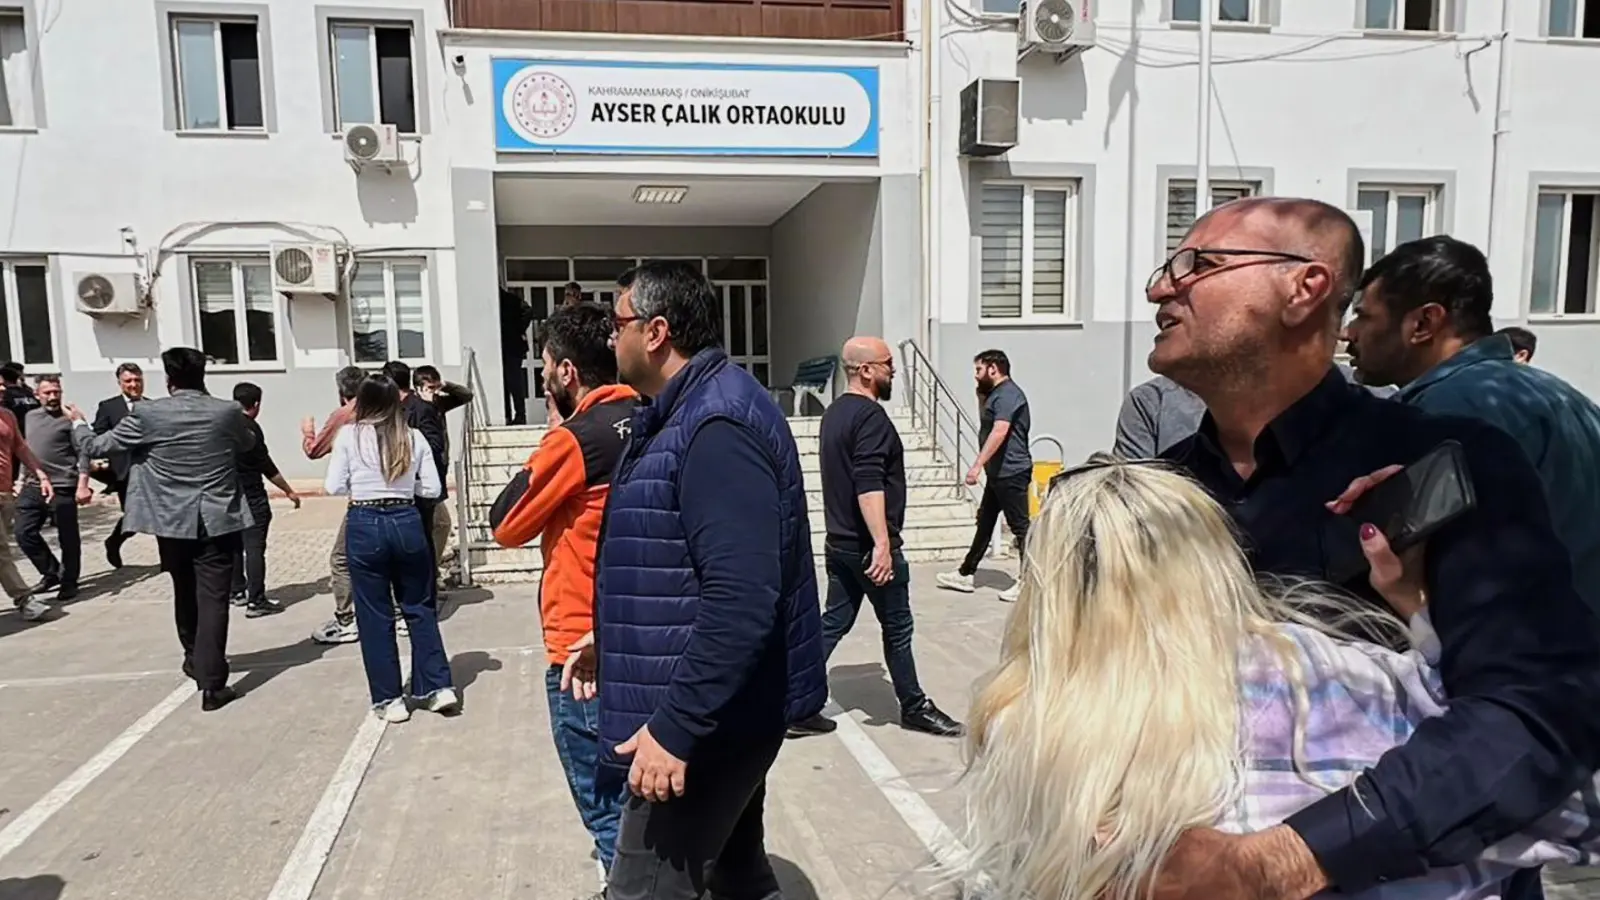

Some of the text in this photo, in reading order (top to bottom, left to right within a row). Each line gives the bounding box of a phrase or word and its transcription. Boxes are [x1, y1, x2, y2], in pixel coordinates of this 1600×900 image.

[588, 85, 683, 99] KAHRAMANMARAŞ
[591, 102, 656, 123] AYSER
[661, 103, 722, 127] ÇALIK
[726, 104, 846, 126] ORTAOKULU
